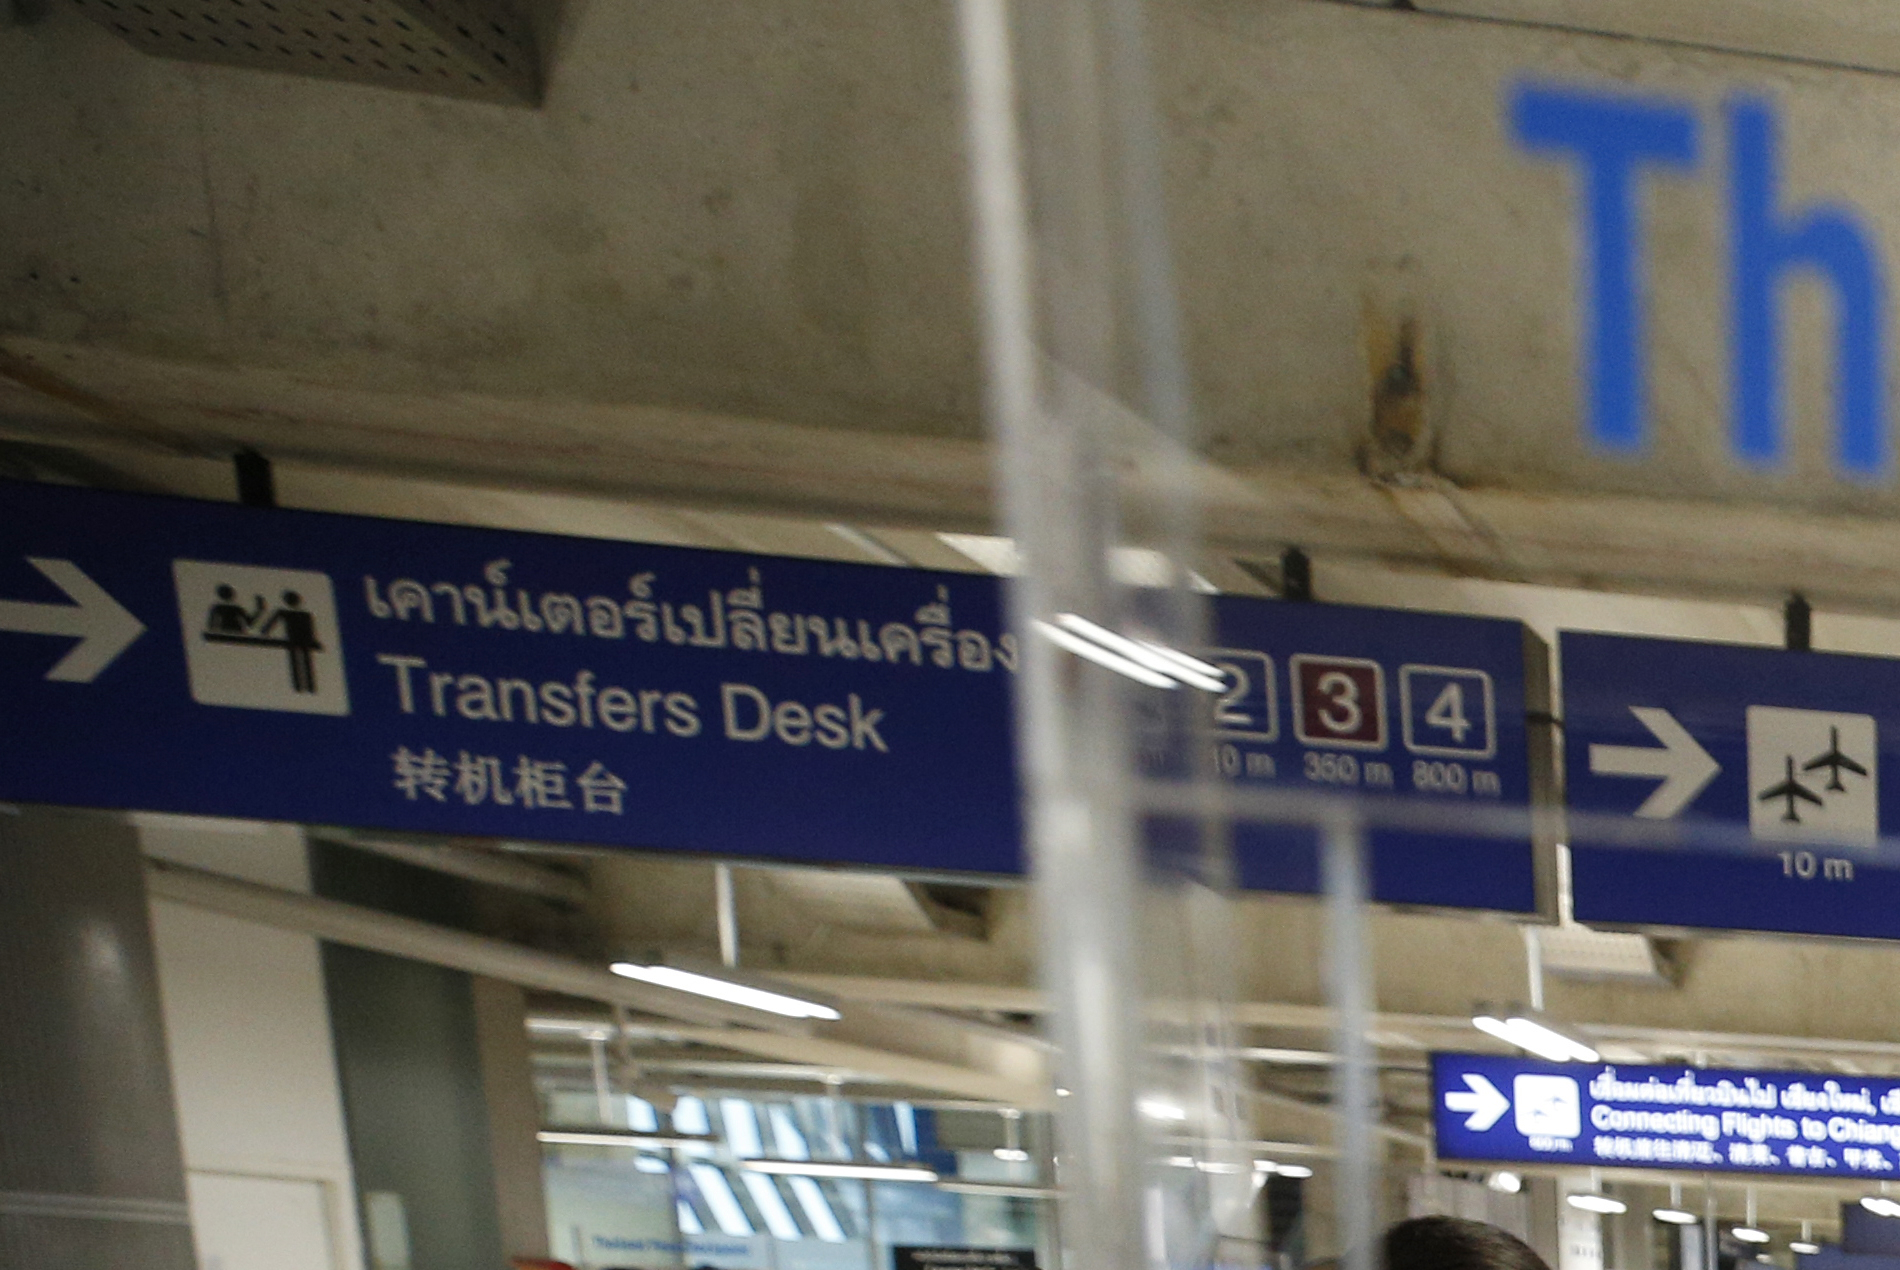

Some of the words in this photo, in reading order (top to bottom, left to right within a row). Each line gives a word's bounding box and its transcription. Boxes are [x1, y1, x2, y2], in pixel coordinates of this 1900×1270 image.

[377, 654, 698, 737] Transfers
[721, 683, 890, 752] Desk
[1315, 674, 1363, 732] 3
[1426, 682, 1471, 740] 4
[391, 746, 627, 816] 转机柜台
[1777, 849, 1814, 878] 10
[1821, 857, 1854, 881] m
[1590, 1104, 1719, 1140] Connecting
[1721, 1110, 1798, 1142] Flights
[1800, 1115, 1827, 1141] to
